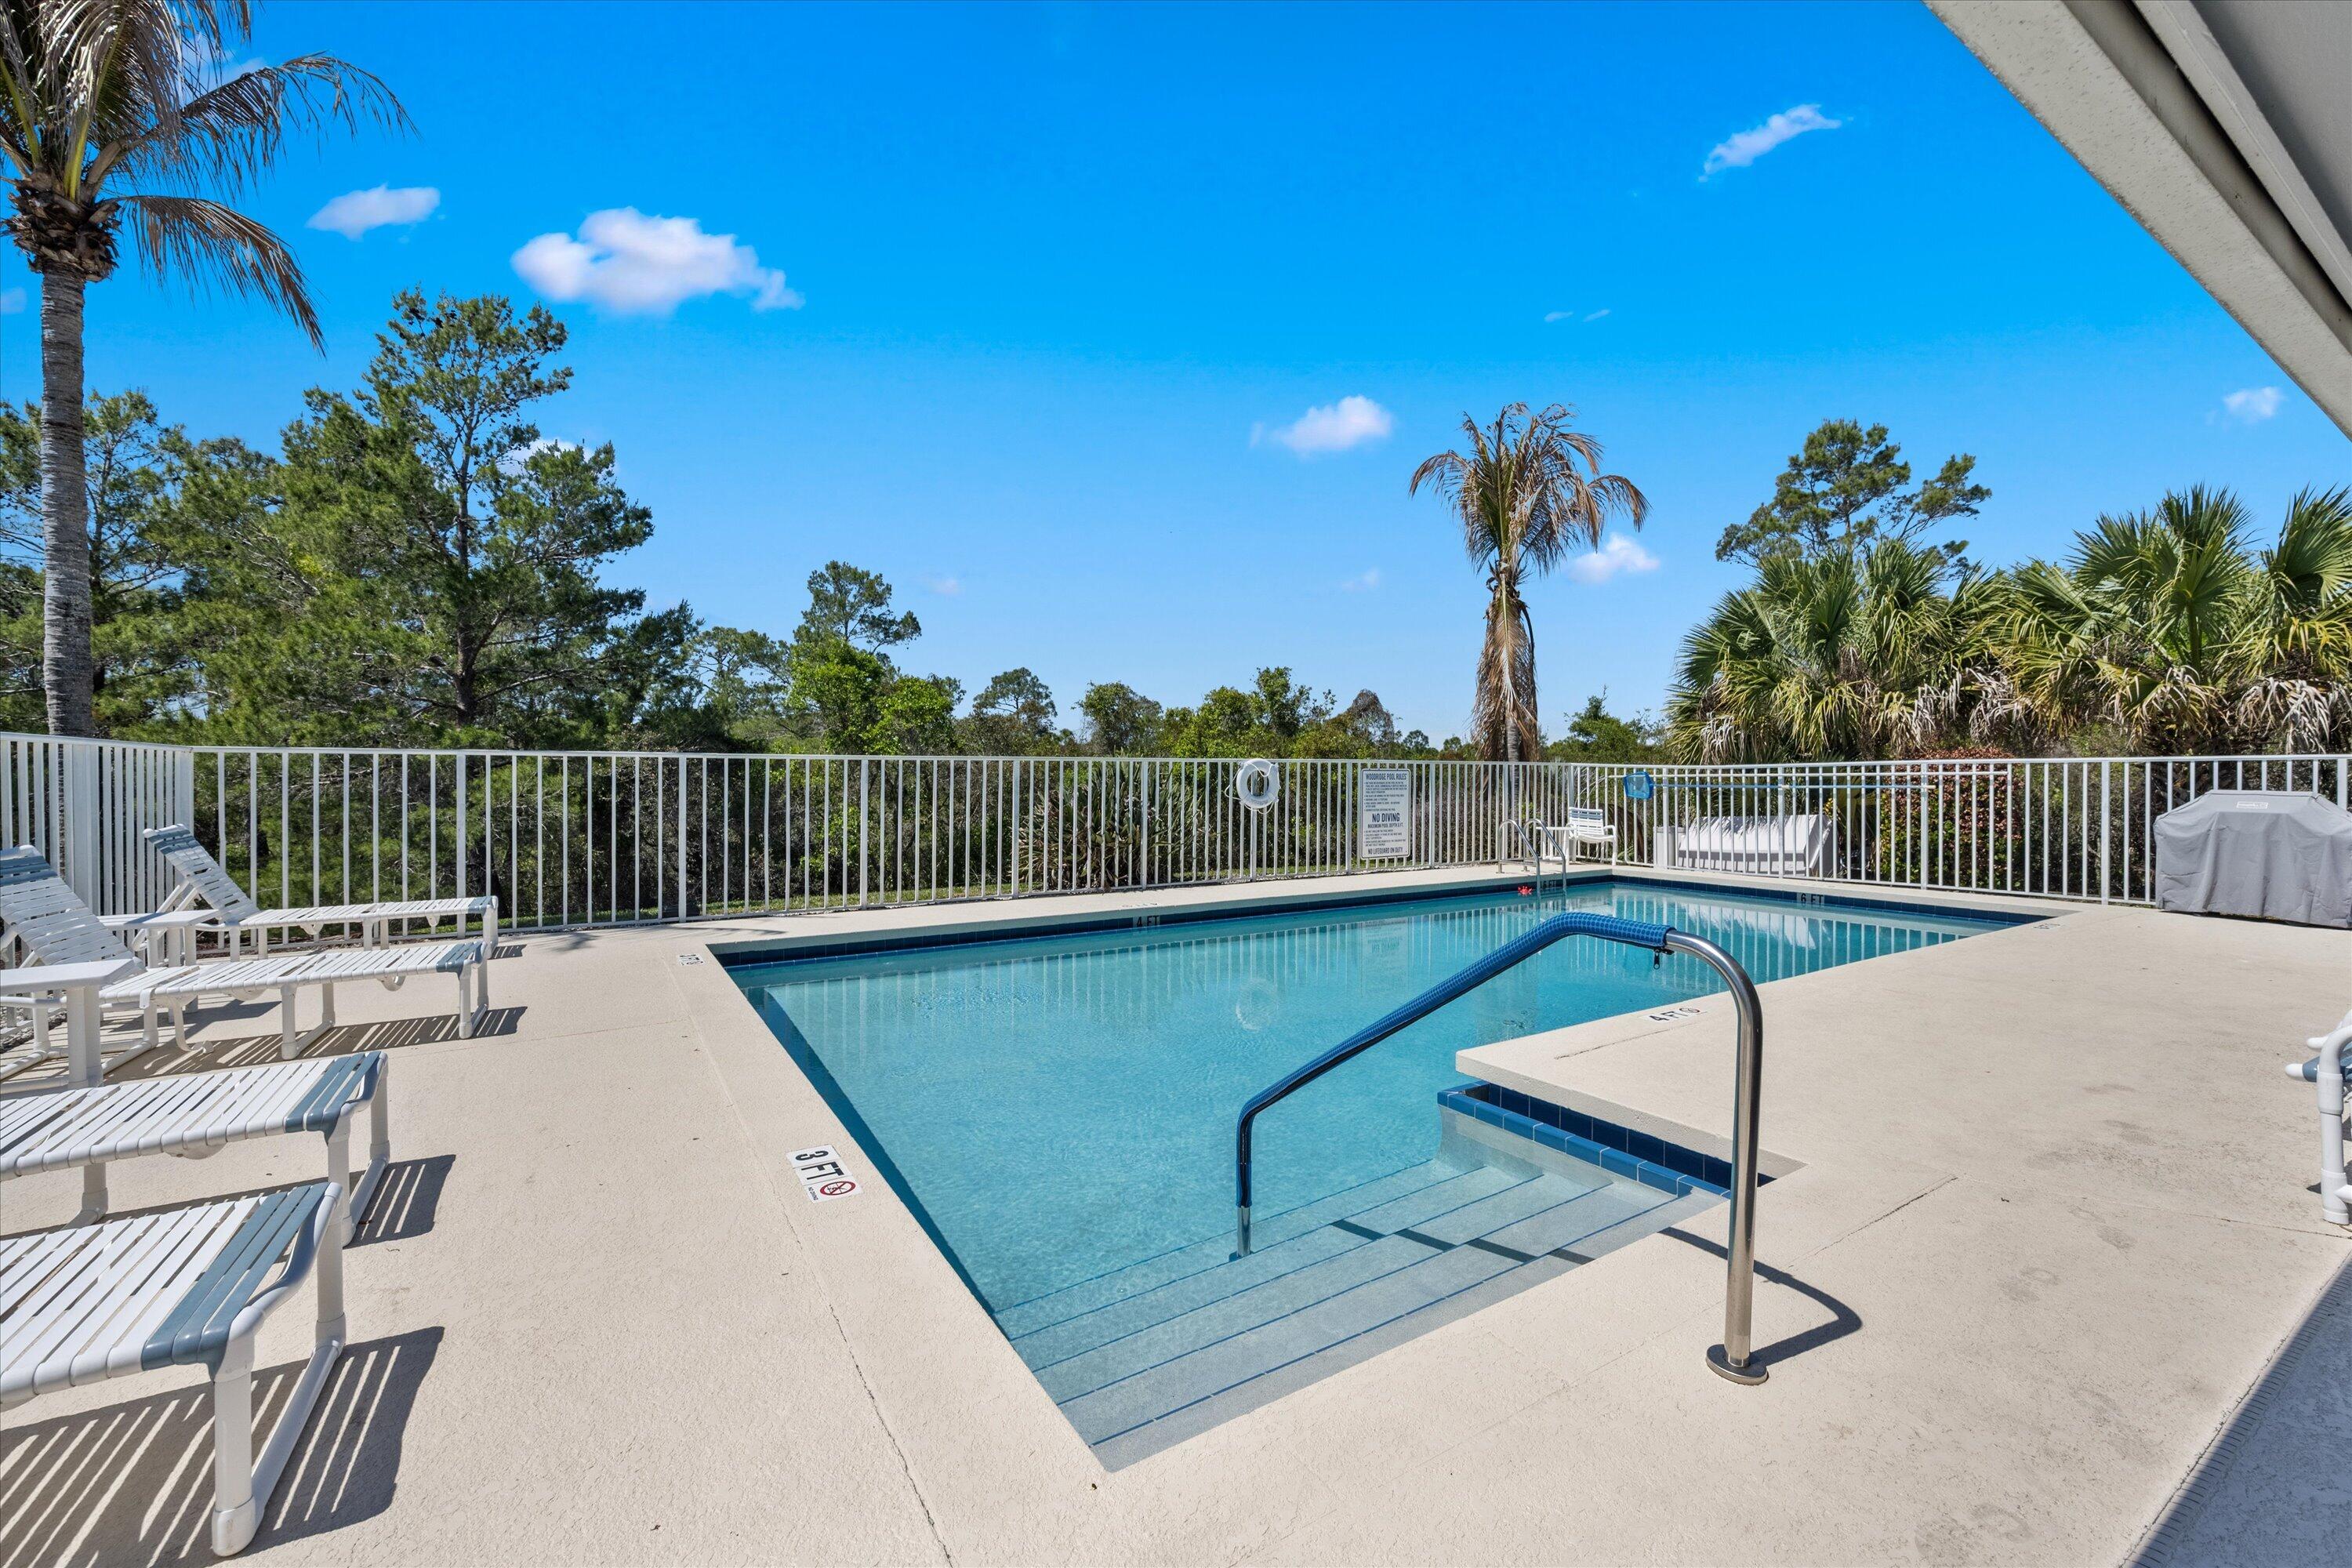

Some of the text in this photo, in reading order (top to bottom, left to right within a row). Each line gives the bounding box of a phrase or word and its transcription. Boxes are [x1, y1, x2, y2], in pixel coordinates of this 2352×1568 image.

[1372, 812, 1400, 822] NO DIVING
[1801, 893, 1824, 903] 6 FT
[1136, 915, 1160, 927] 4 FT
[795, 1150, 844, 1180] 3 FT
